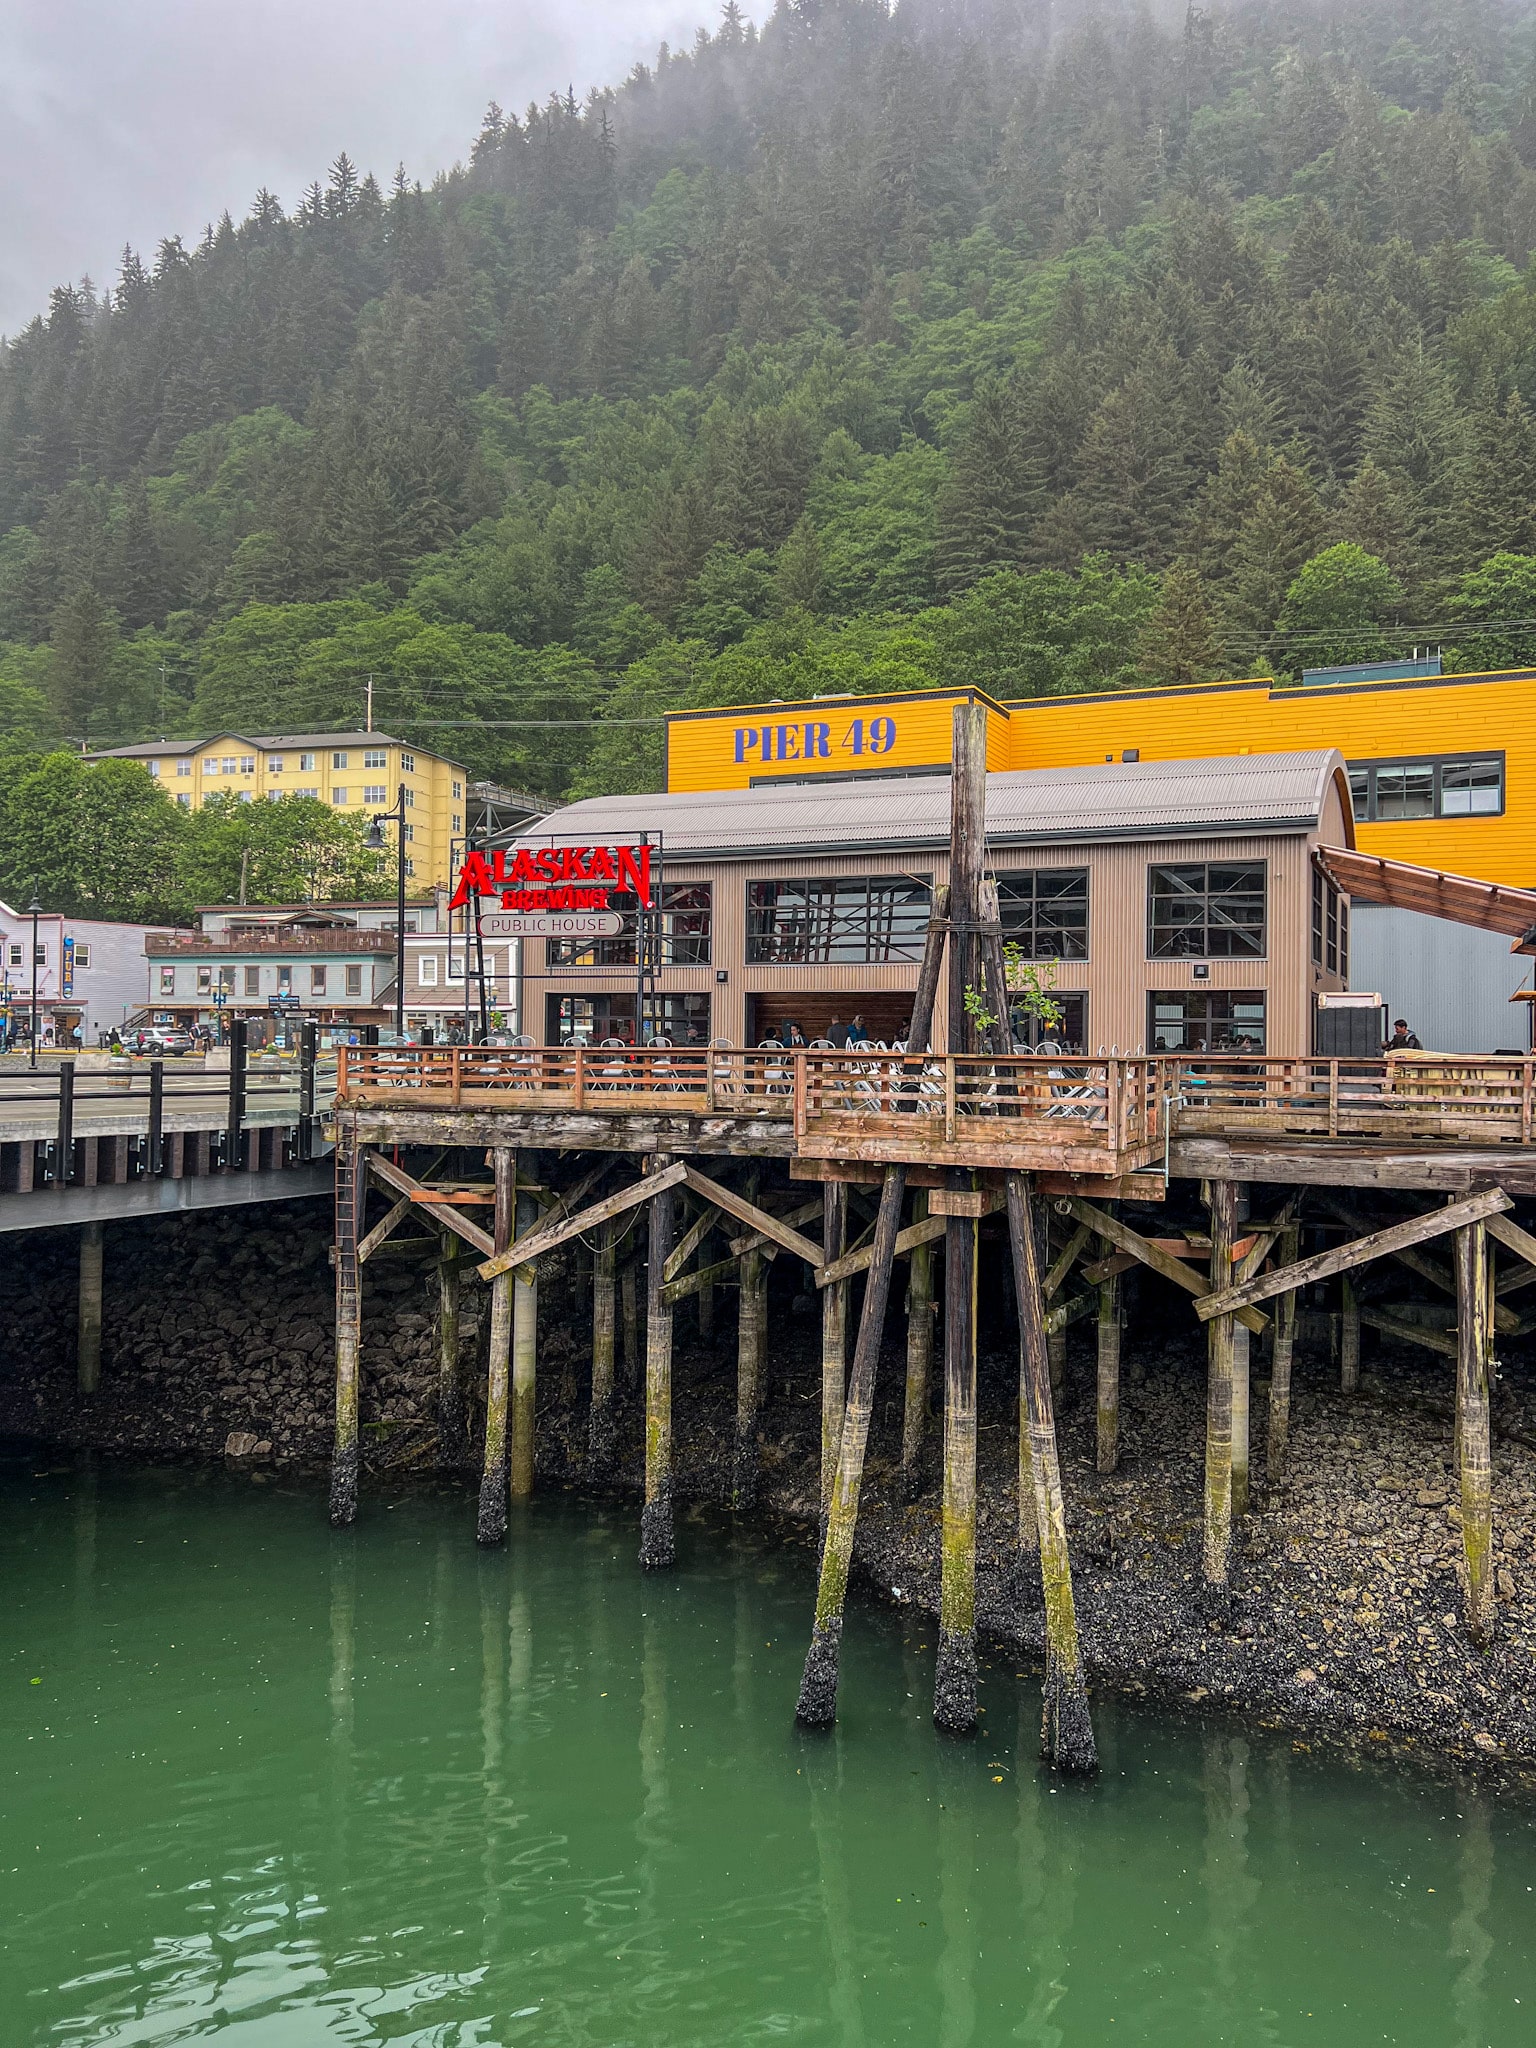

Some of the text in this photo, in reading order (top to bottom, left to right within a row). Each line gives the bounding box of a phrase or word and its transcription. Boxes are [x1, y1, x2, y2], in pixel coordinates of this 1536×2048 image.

[732, 716, 897, 763] PIER 49
[448, 844, 656, 911] ALASKAN
[501, 883, 611, 912] BREWING
[491, 917, 607, 932] PUBLIC HOUSE
